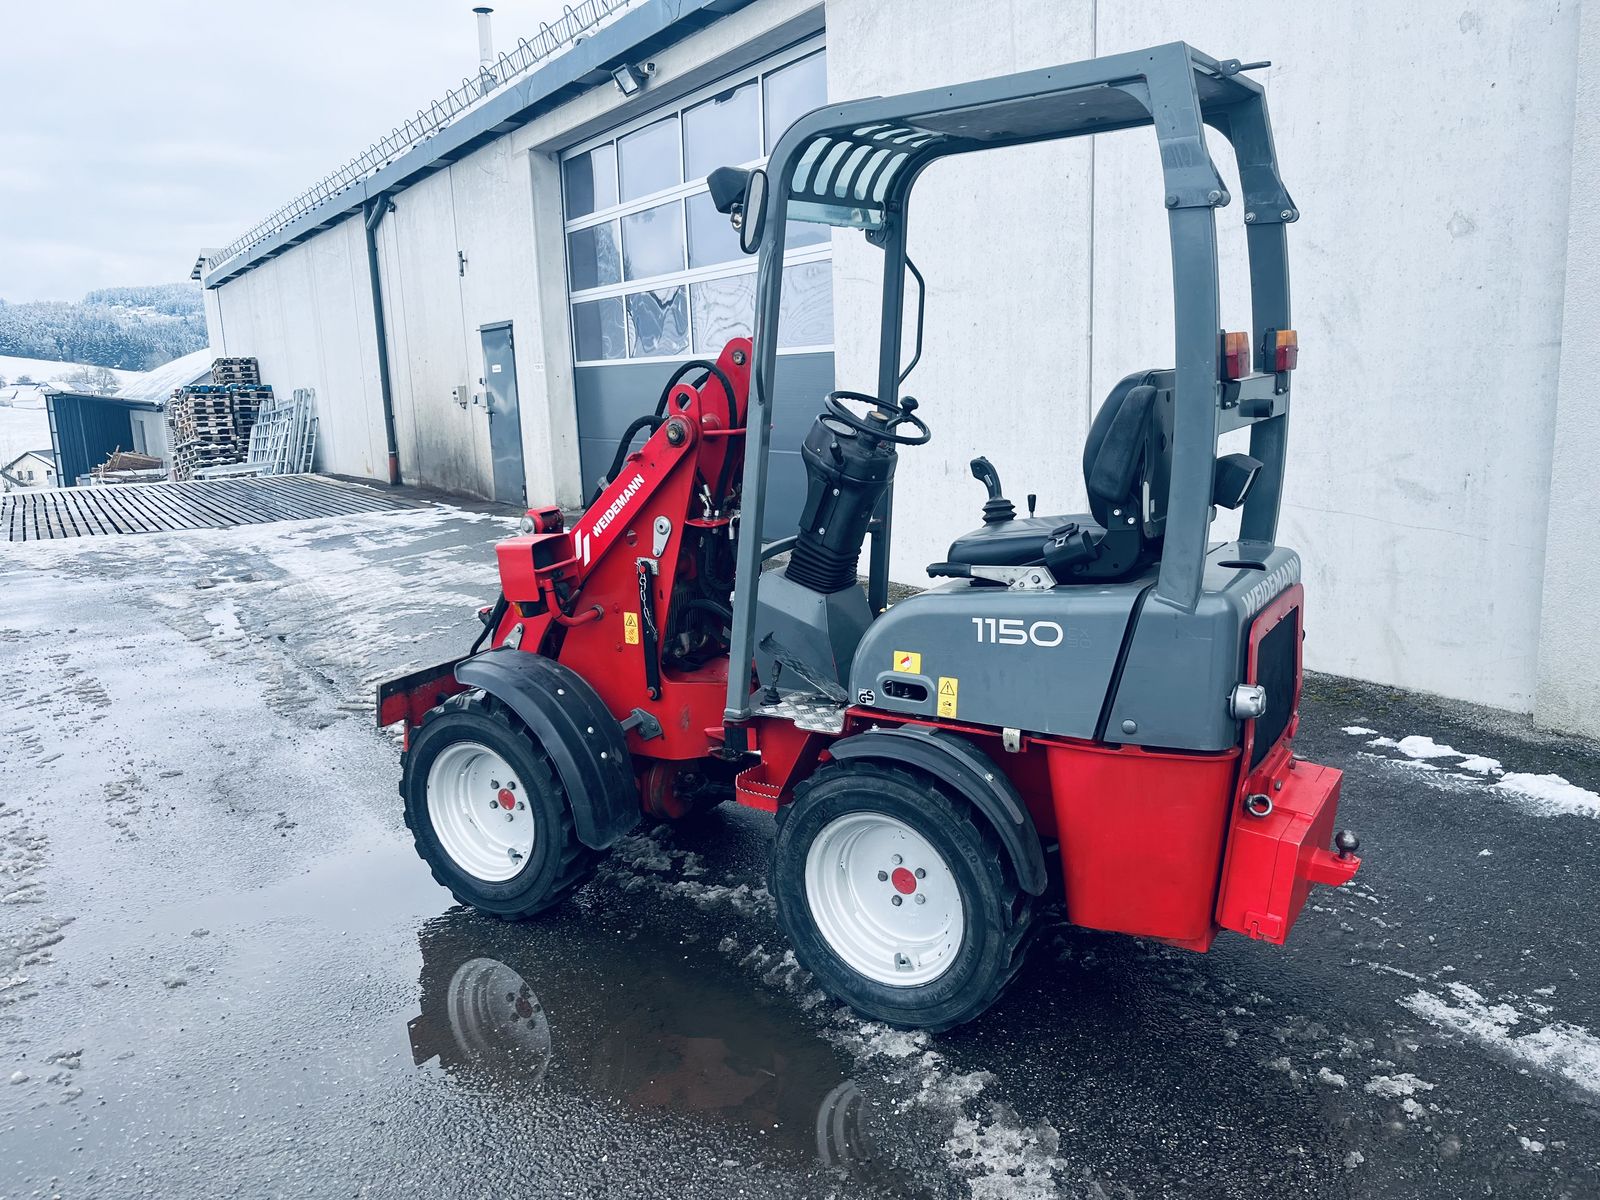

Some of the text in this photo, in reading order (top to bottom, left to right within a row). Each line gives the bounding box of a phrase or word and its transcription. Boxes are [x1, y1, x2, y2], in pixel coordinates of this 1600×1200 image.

[592, 473, 646, 538] WEIDEMANN
[1241, 555, 1299, 618] WEIDEMANN
[971, 617, 1064, 647] 1150
[858, 690, 874, 703] GS
